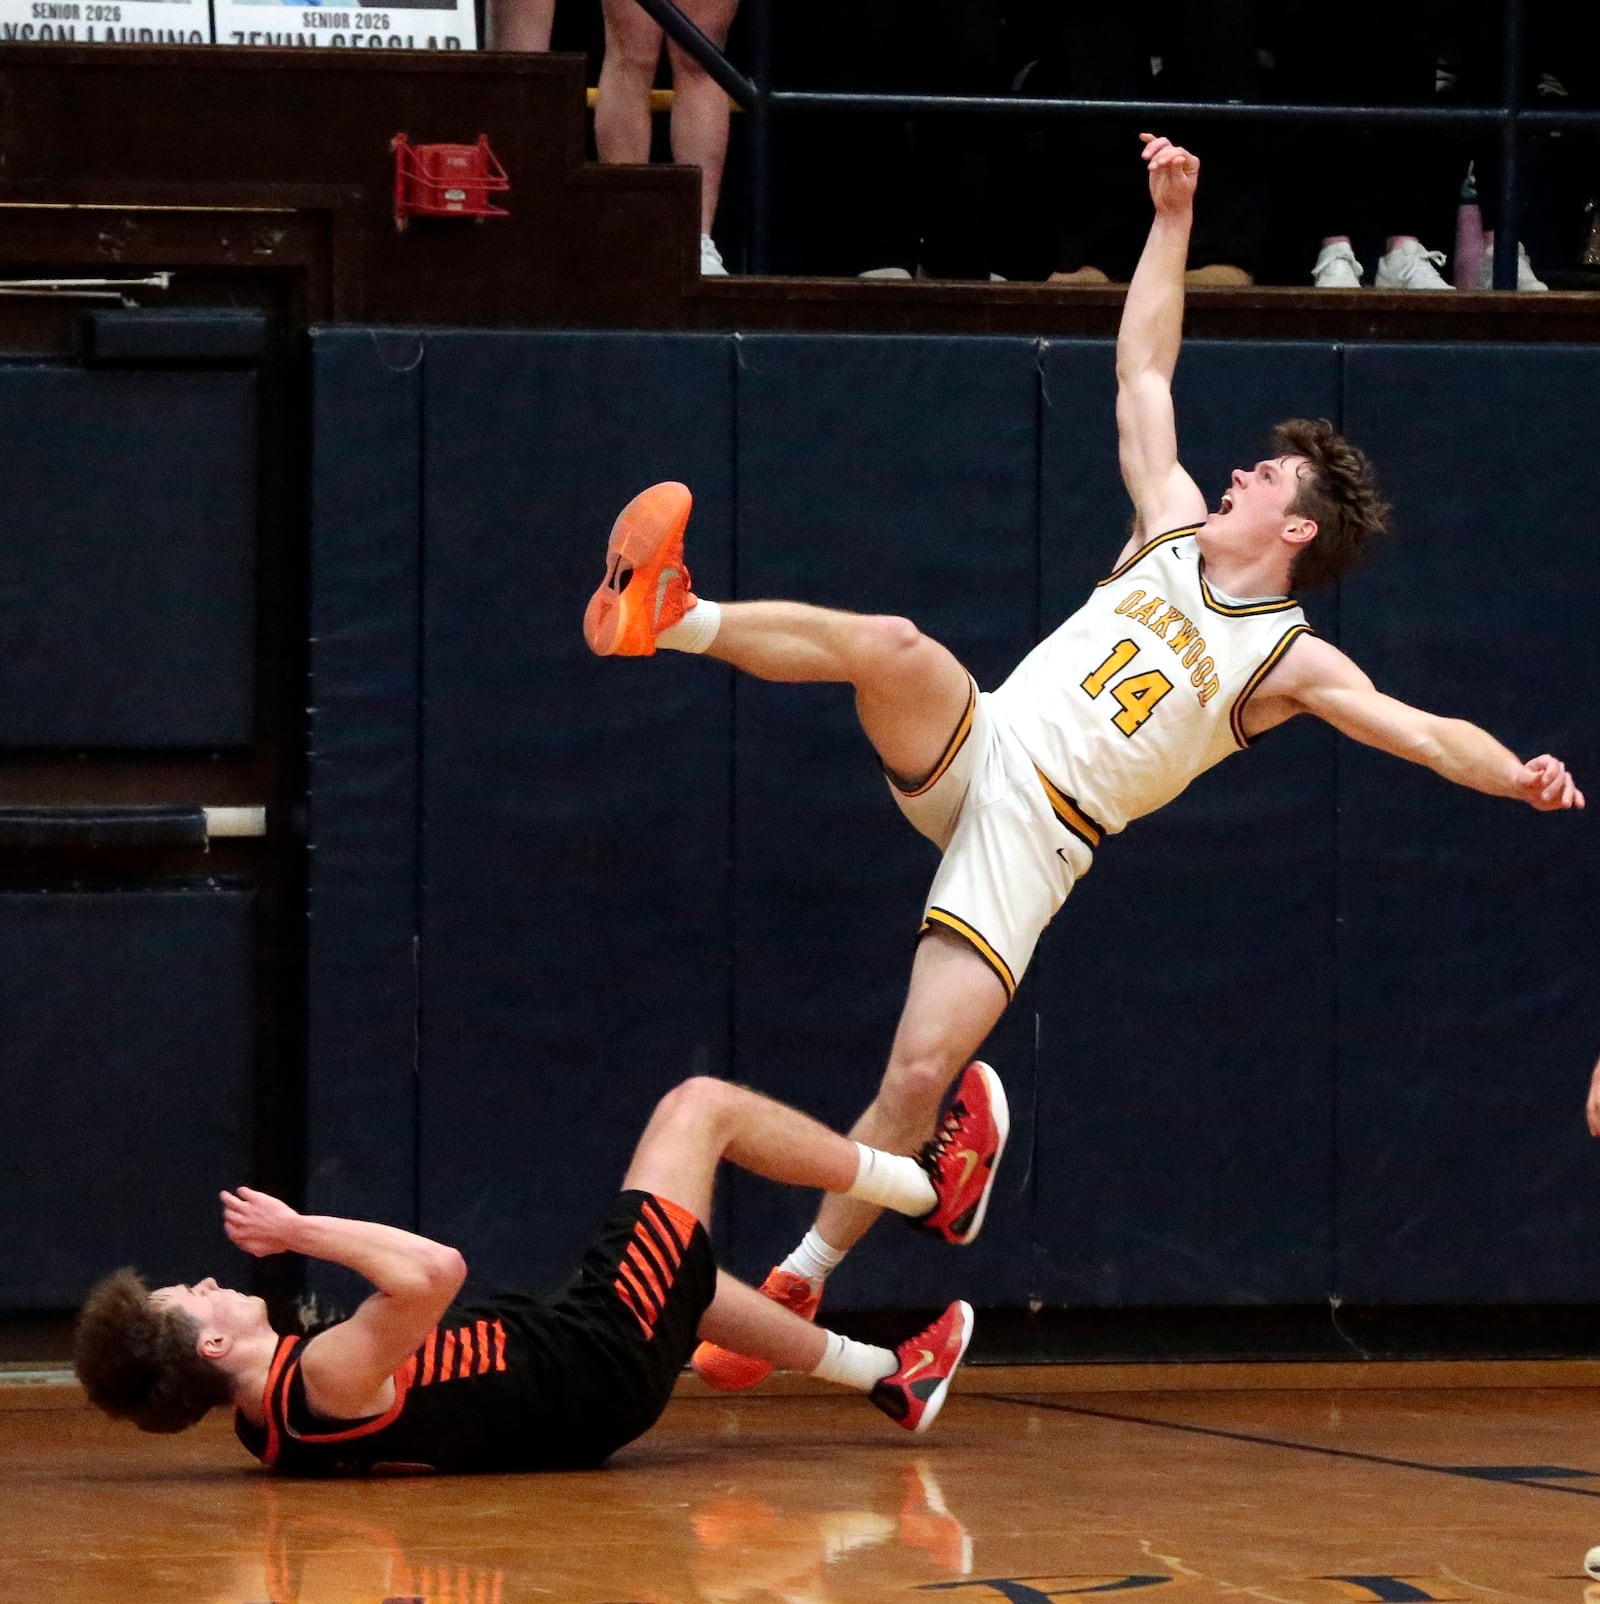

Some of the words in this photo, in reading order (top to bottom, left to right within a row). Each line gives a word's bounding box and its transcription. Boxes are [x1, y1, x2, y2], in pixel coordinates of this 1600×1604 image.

[32, 2, 80, 19] SENIOR
[86, 5, 121, 22] 2026
[303, 11, 349, 29] SENIOR
[355, 13, 390, 30] 2026
[1114, 590, 1220, 707] OAKWOOD
[1080, 638, 1175, 739] 14
